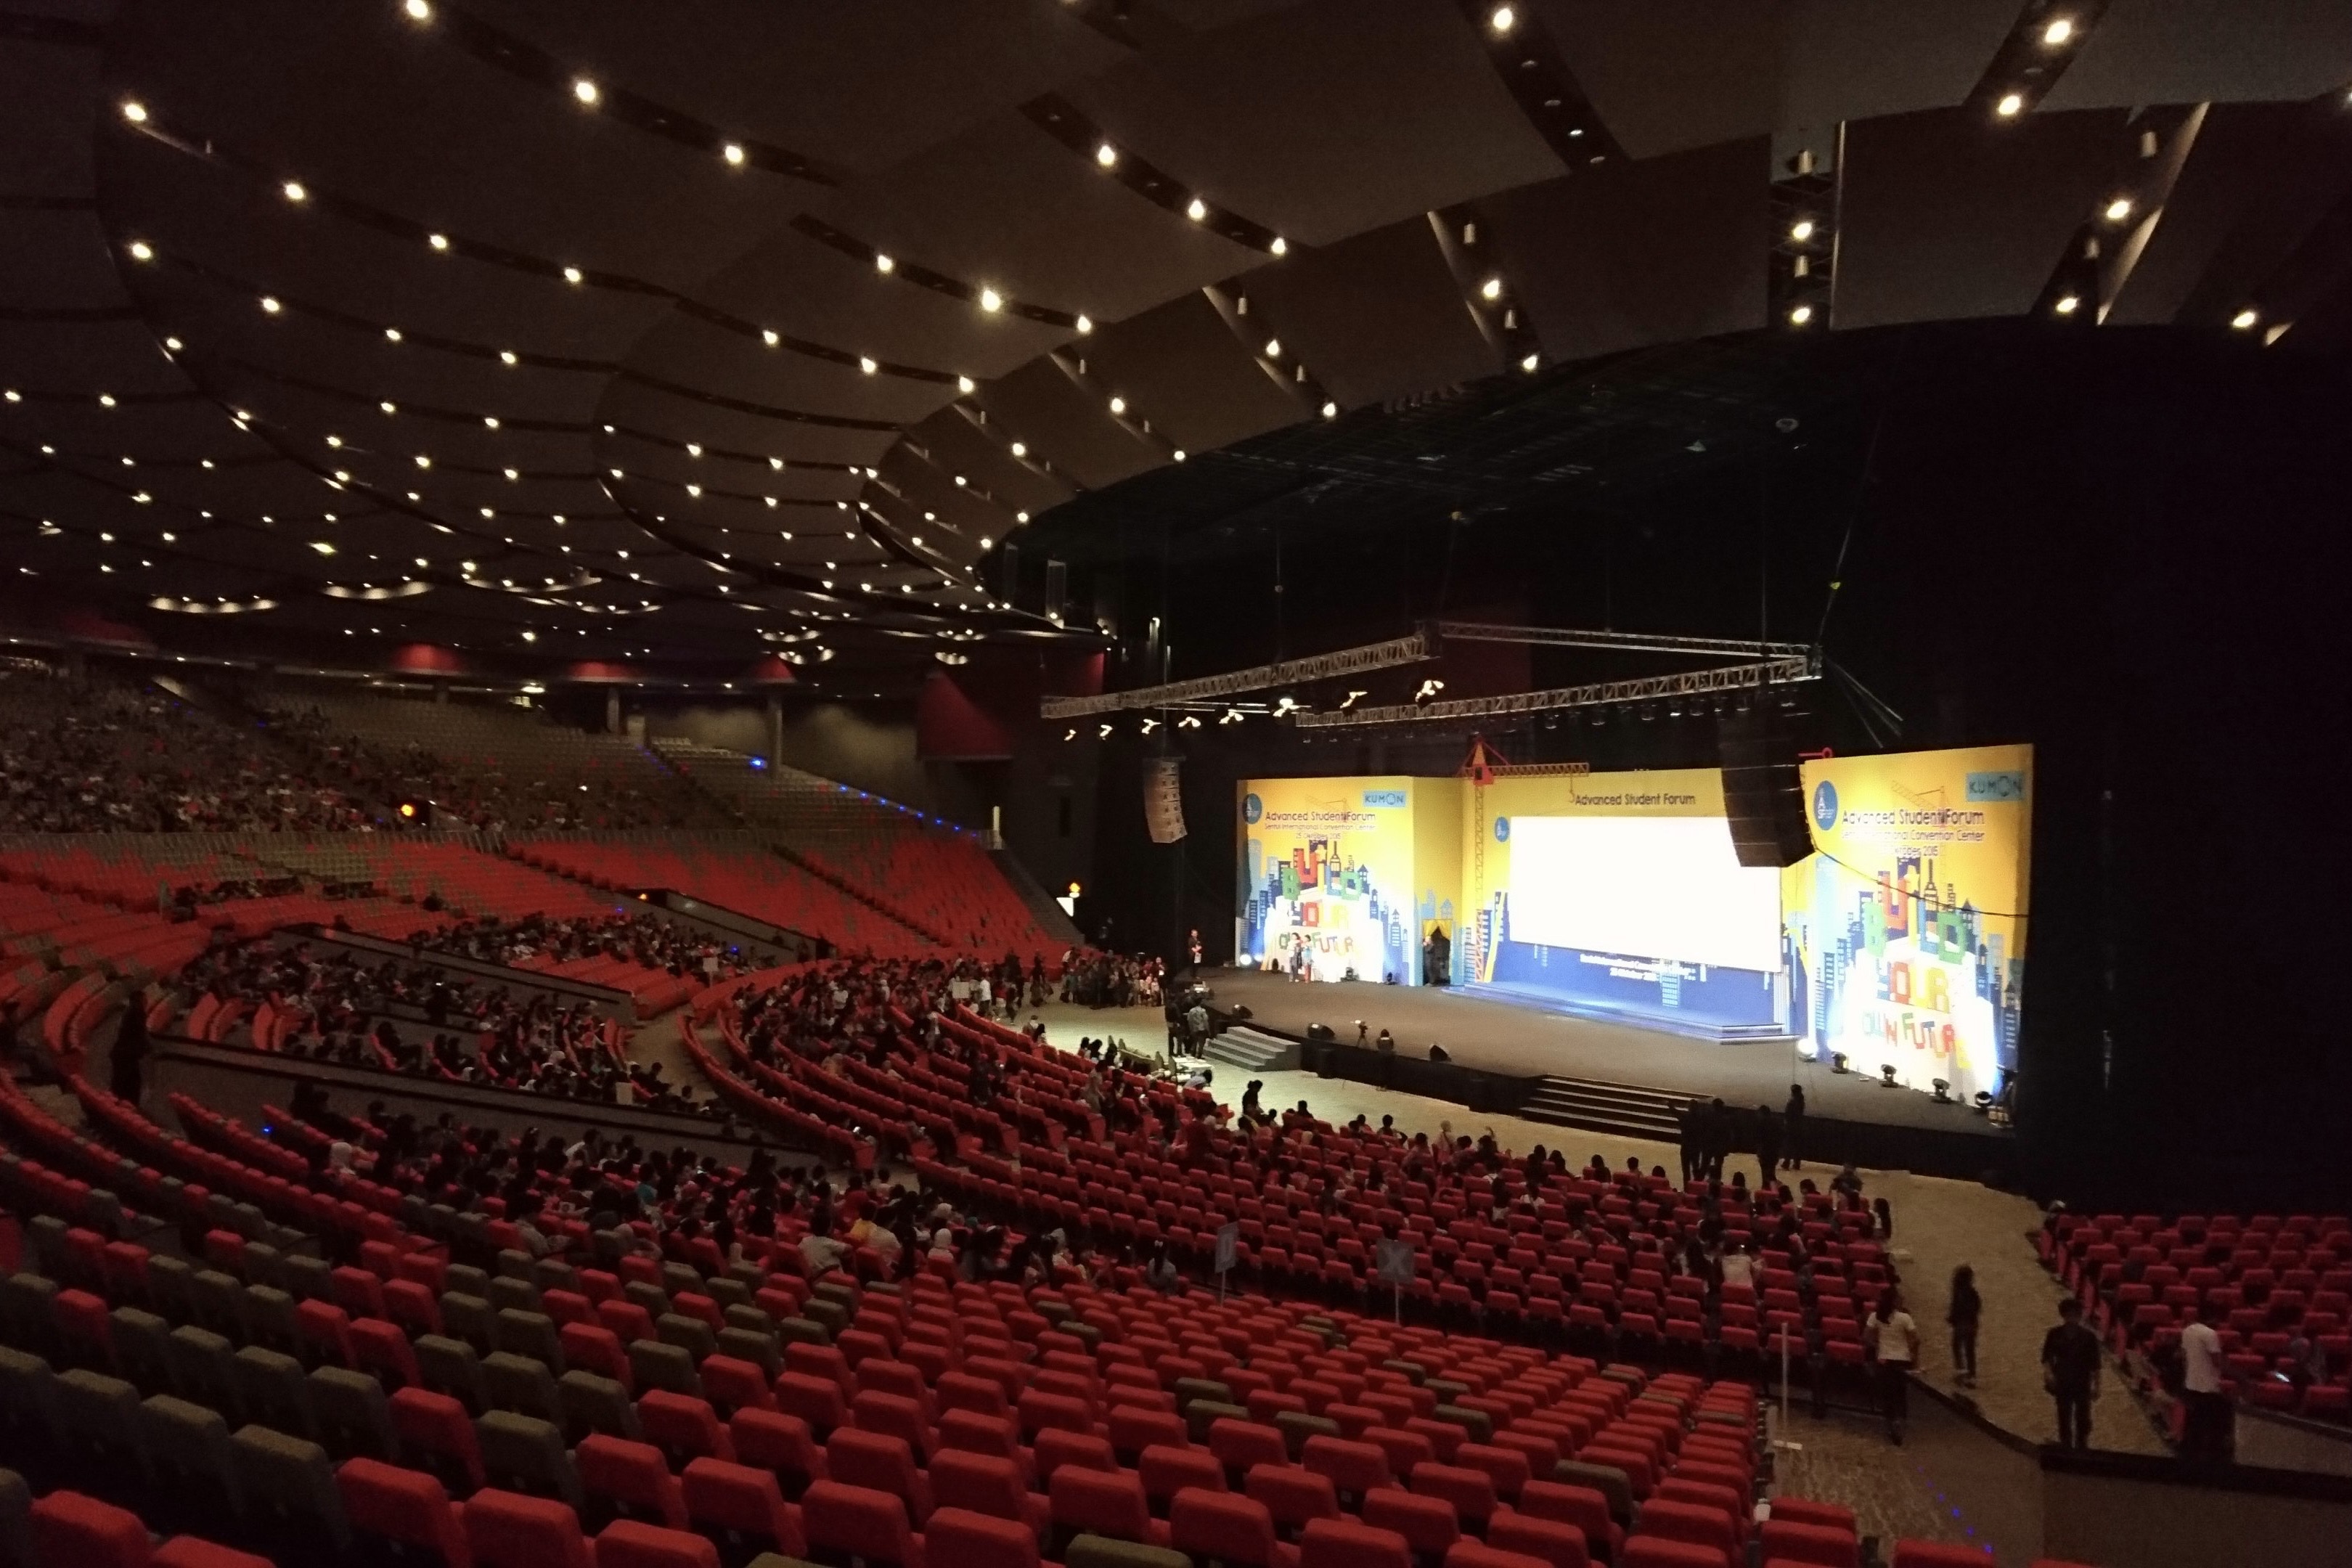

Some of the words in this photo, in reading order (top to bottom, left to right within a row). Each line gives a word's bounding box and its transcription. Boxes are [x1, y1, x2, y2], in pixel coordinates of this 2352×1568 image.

[1969, 776, 2022, 797] KUMON
[1365, 793, 1404, 805] KUMON
[1576, 793, 1622, 805] Advanced
[1625, 793, 1660, 805] Student
[1663, 793, 1696, 805] Forum
[1265, 812, 1308, 821] Advanced
[1310, 812, 1344, 821] Student
[1347, 811, 1376, 821] Forum
[1842, 809, 1895, 825] Advanced
[1900, 808, 1940, 825] Student
[1945, 808, 1985, 825] Forum
[1957, 829, 1985, 841] Center
[1282, 846, 1362, 901] BUILD
[1863, 869, 1966, 965] BUILD
[1311, 932, 1359, 957] FUTUR
[1876, 958, 1950, 1014] YOUR
